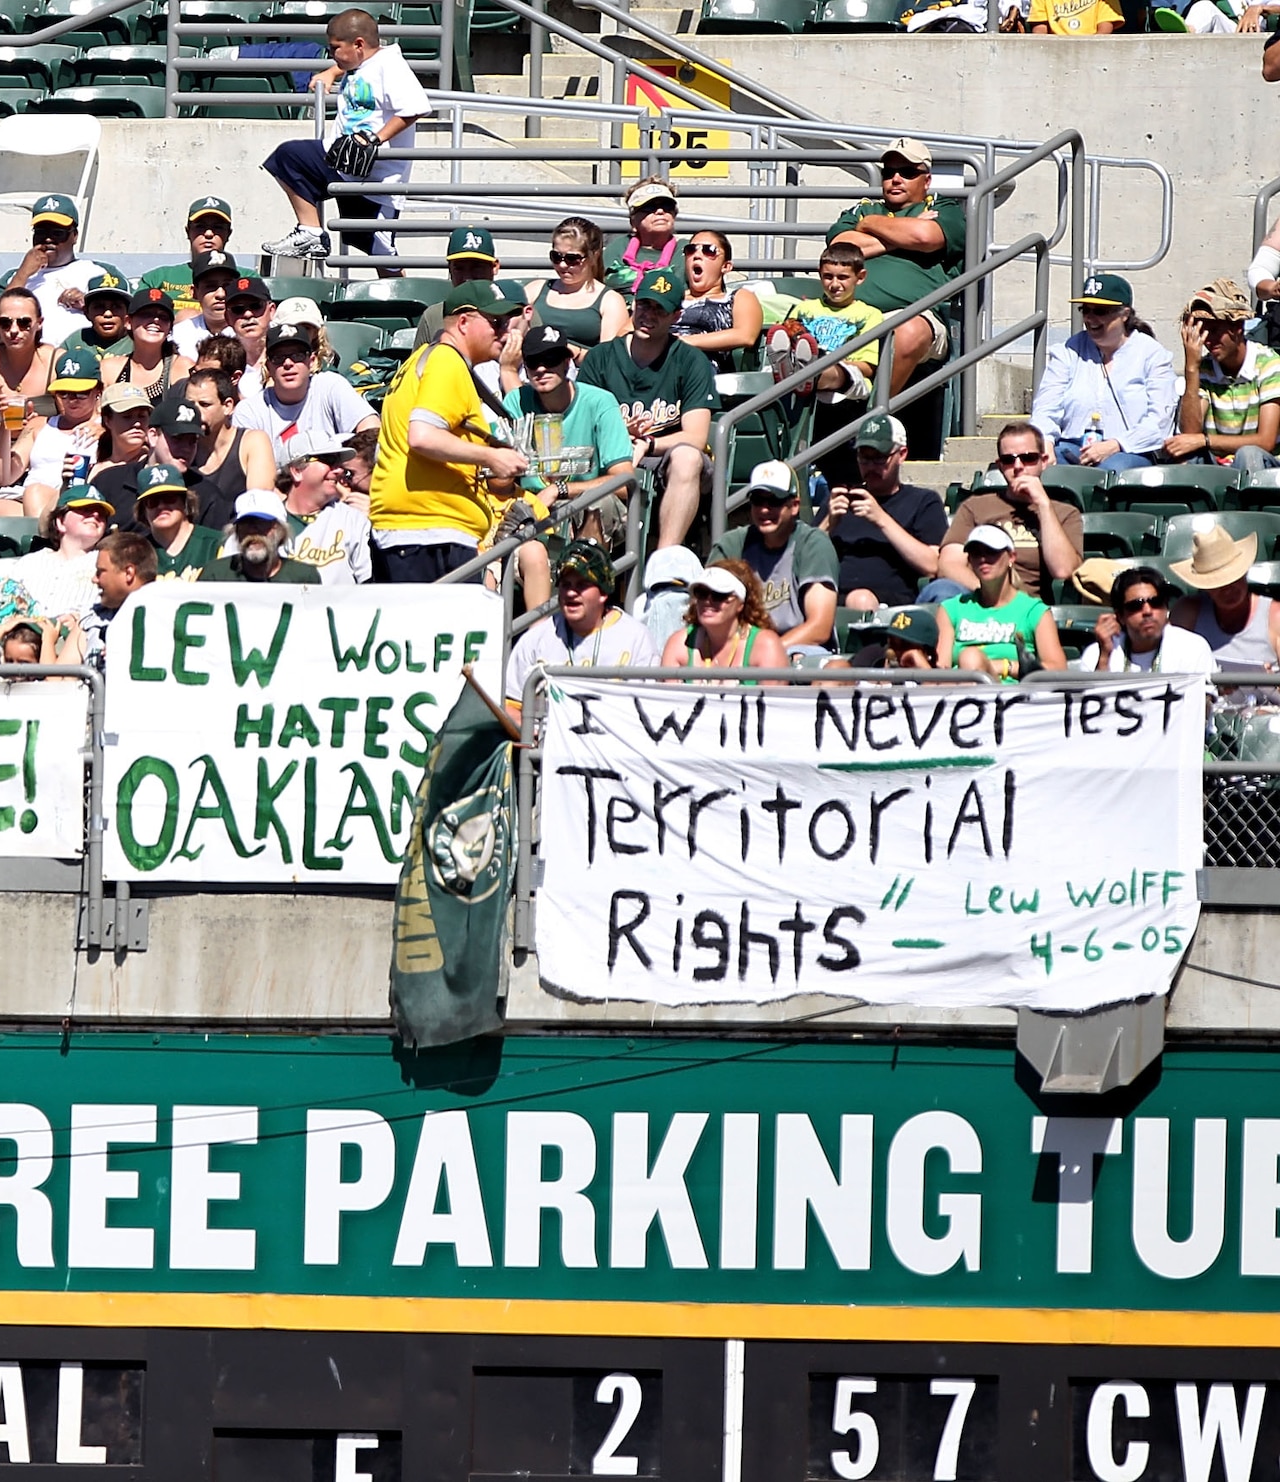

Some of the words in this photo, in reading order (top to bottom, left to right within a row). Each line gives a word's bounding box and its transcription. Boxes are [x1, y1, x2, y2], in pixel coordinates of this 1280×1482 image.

[129, 602, 293, 688] LEW
[326, 606, 489, 676] WOLFF
[235, 691, 439, 768] HATES
[635, 690, 765, 752] Will
[815, 690, 1031, 752] Never
[1050, 683, 1185, 739] Test
[117, 753, 417, 872] OAKLAN
[964, 880, 1040, 916] Lew
[1029, 926, 1185, 976] 4-6-05
[302, 1108, 984, 1277] PARKING
[590, 1372, 643, 1477] 2
[1086, 1378, 1280, 1482] CW
